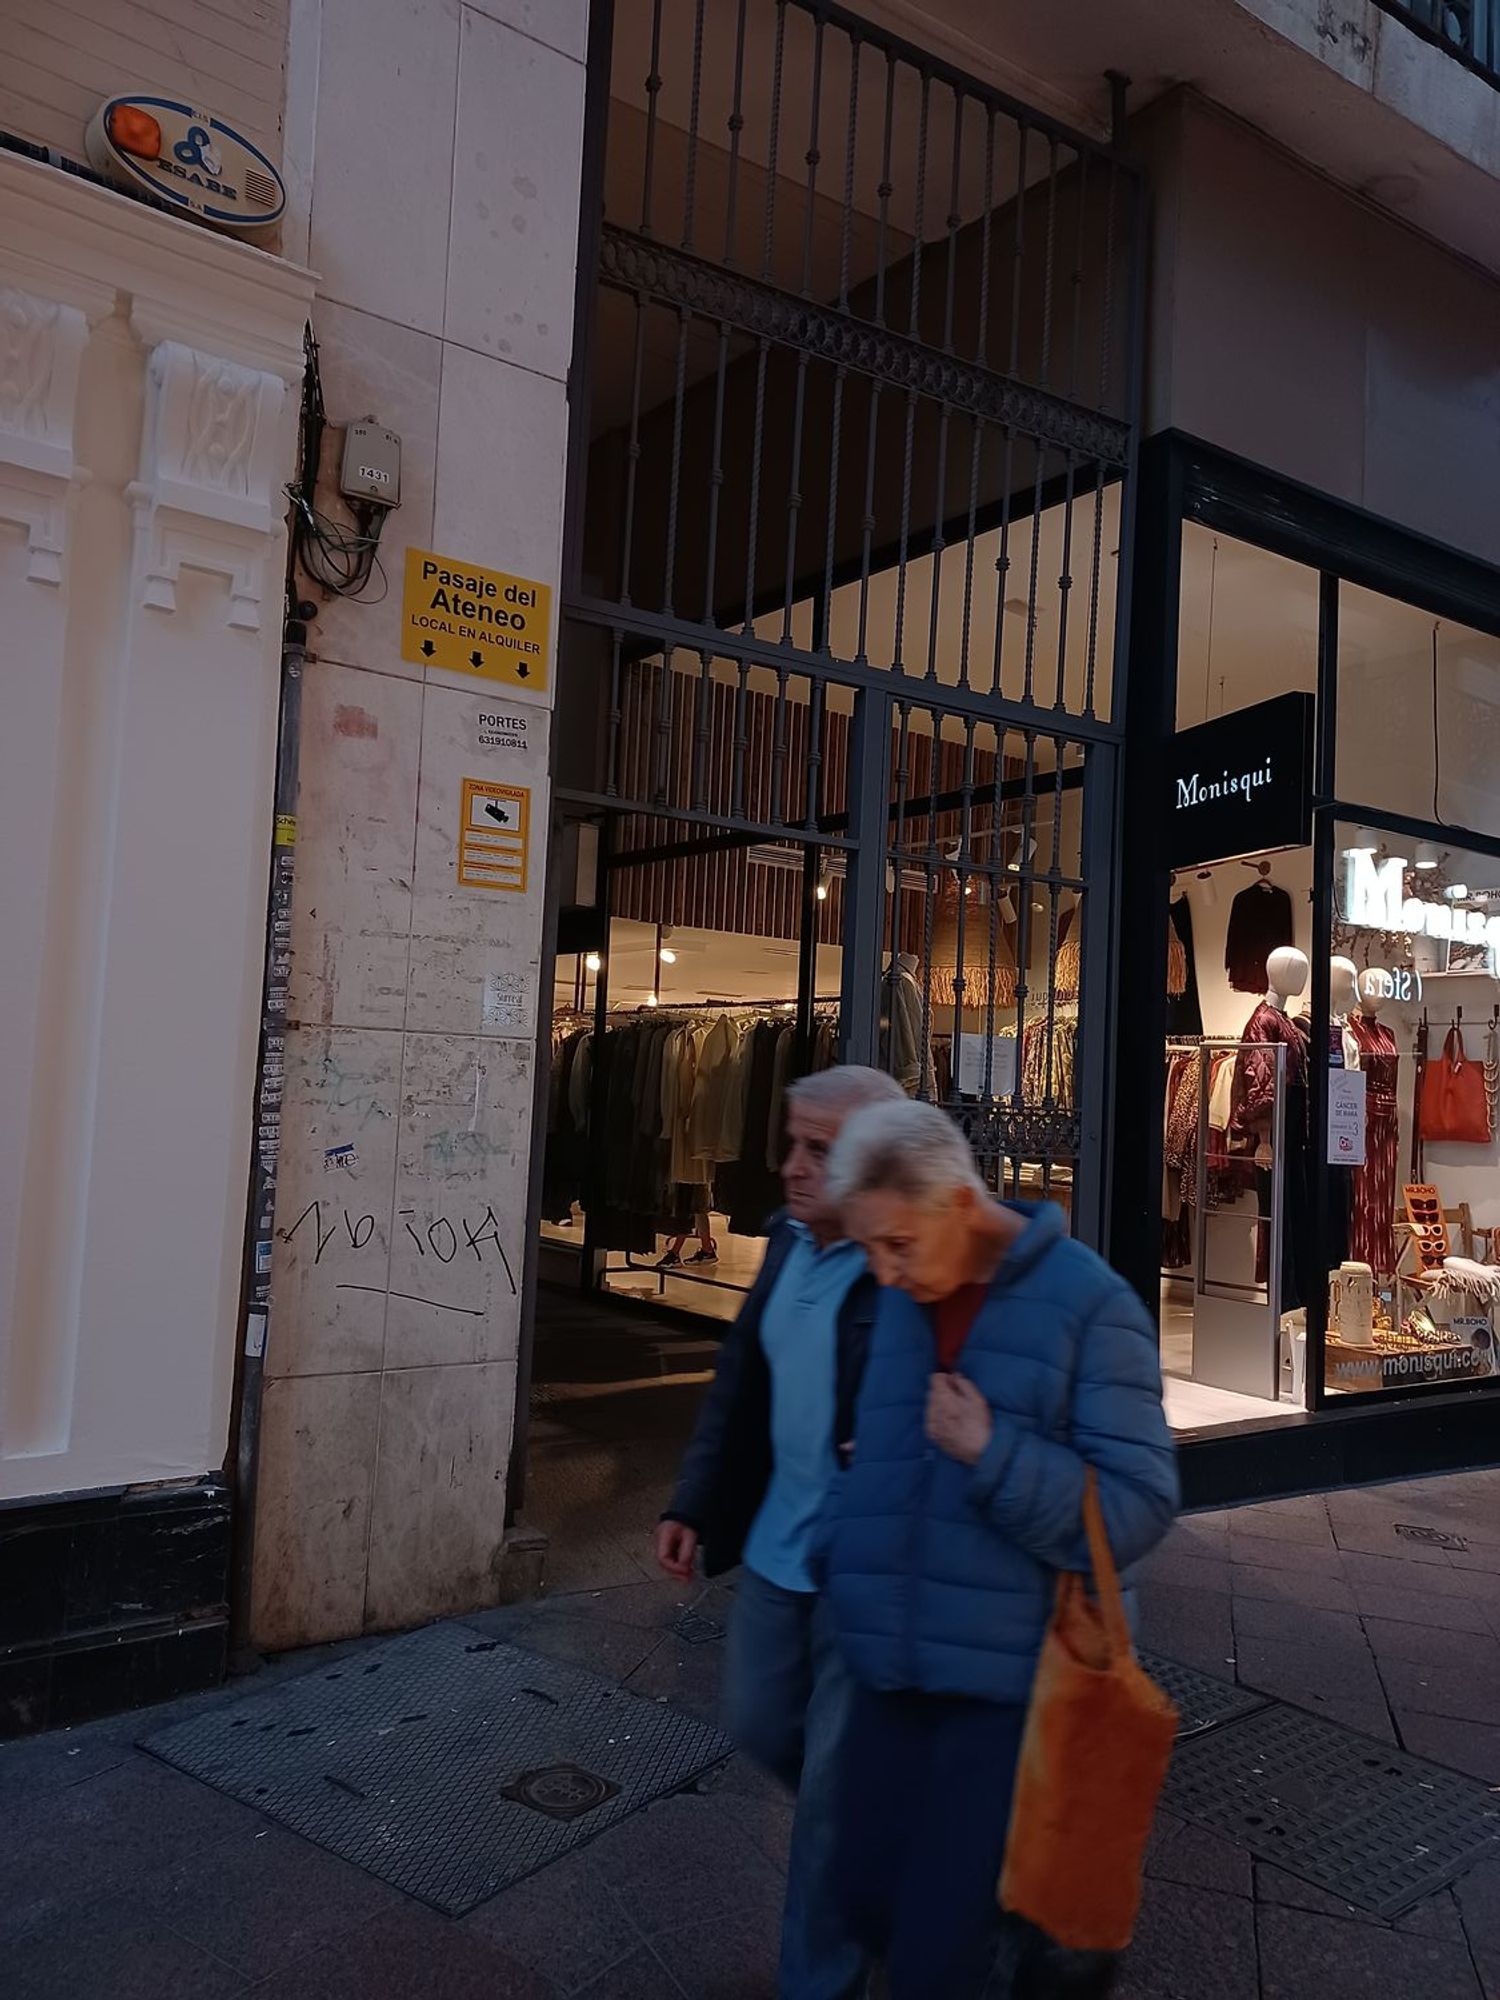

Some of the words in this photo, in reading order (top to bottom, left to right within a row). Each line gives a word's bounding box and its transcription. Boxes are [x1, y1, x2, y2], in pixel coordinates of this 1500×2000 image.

[156, 157, 237, 200] ESABE
[360, 467, 388, 482] 1431
[422, 560, 497, 599] Pasaje
[504, 585, 536, 608] del
[430, 588, 526, 631] Ateneo
[411, 614, 455, 635] LOCAL
[458, 625, 476, 639] EN
[478, 631, 541, 655] ALQUILER
[479, 714, 527, 730] PORTES
[1176, 757, 1272, 809] Monisqui
